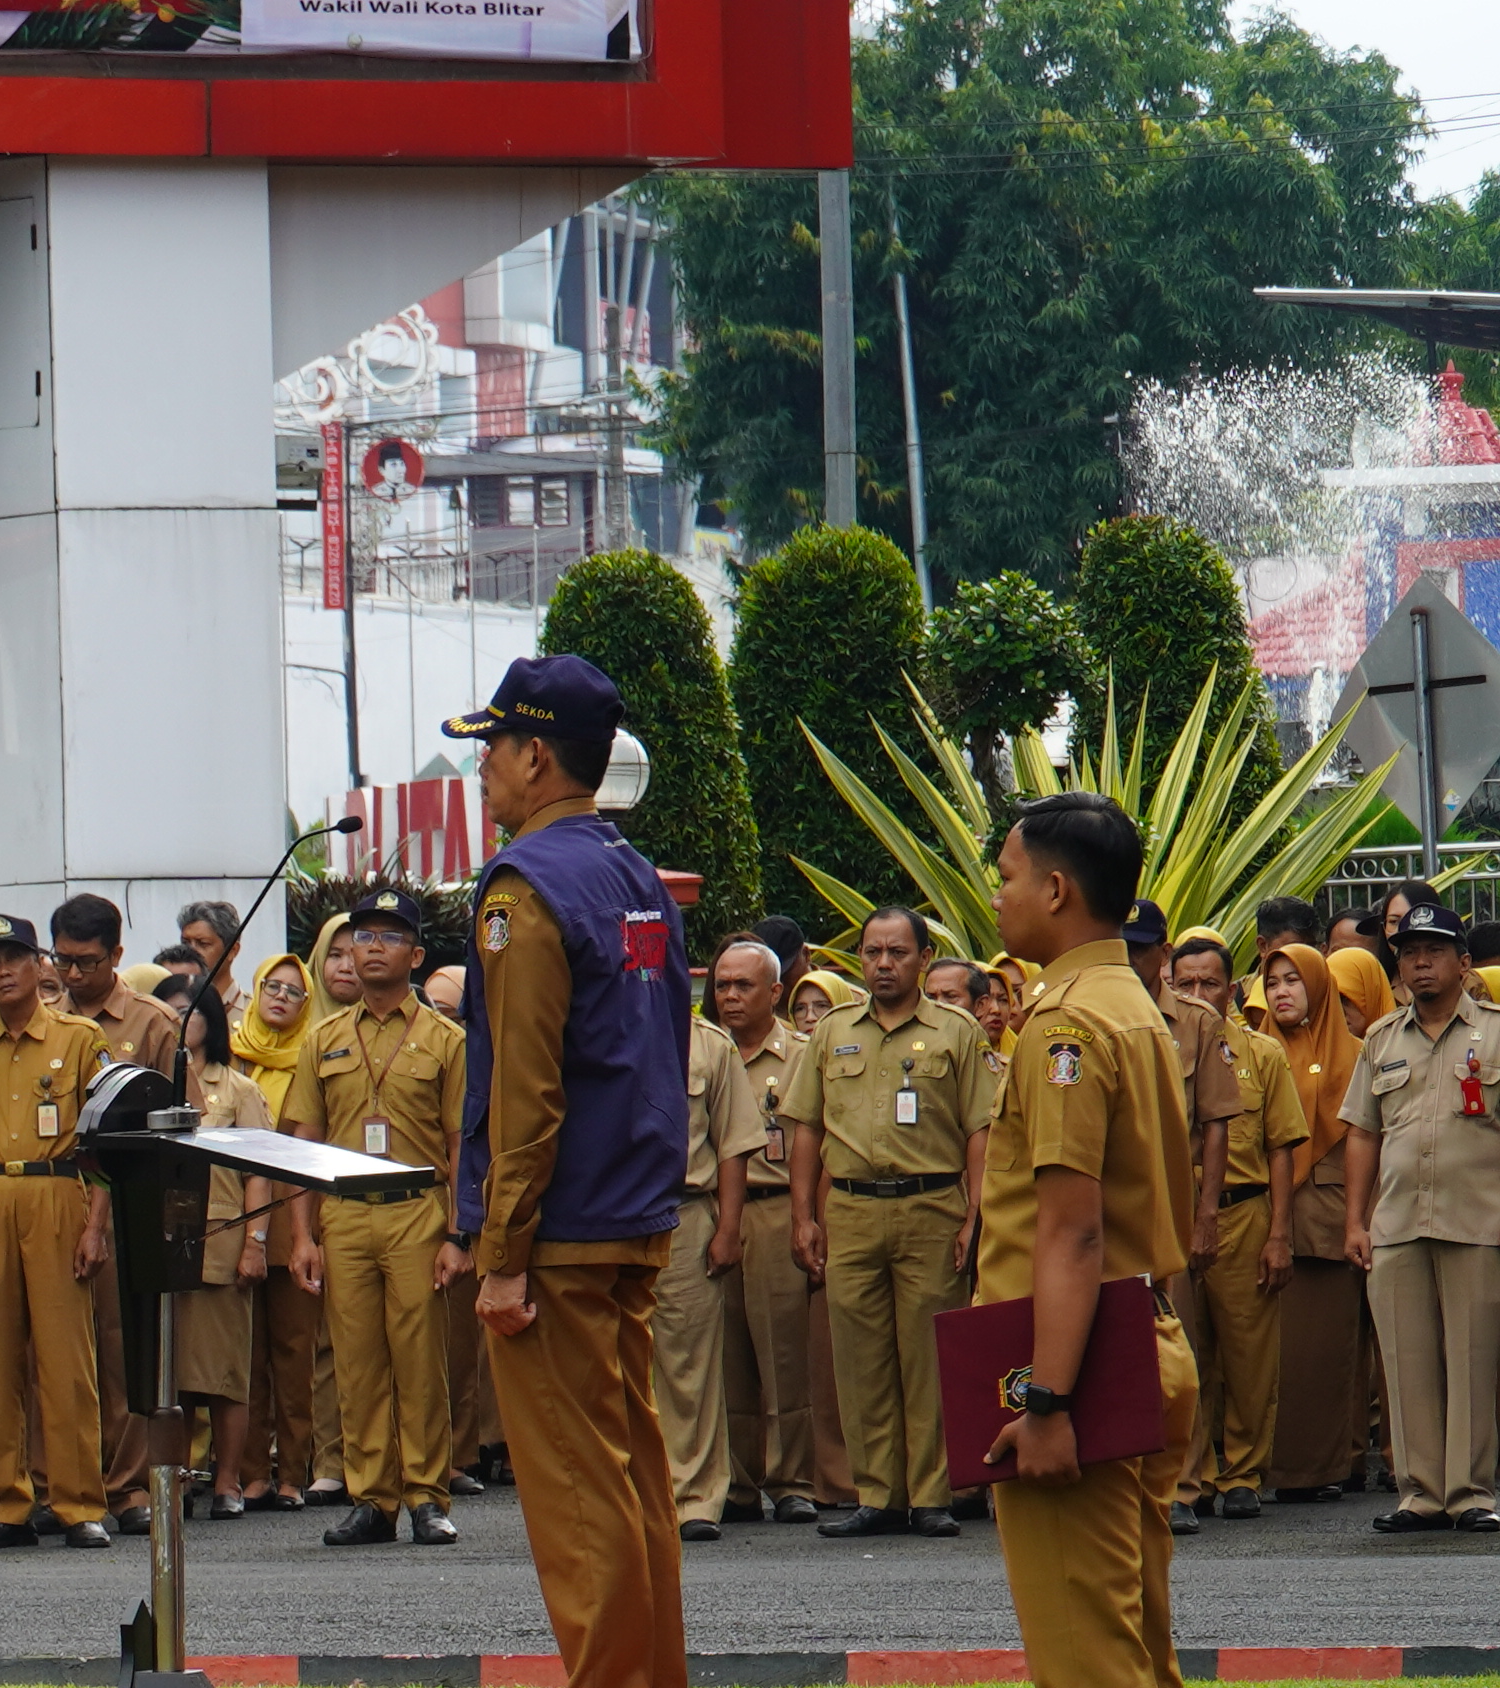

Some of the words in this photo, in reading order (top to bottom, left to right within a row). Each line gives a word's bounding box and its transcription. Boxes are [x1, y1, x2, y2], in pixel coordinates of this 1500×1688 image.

[300, 0, 362, 13] Wakil
[368, 0, 419, 14] Wali
[426, 0, 477, 15] Kota
[484, 0, 546, 16] Blitar
[515, 701, 555, 721] SEKDA
